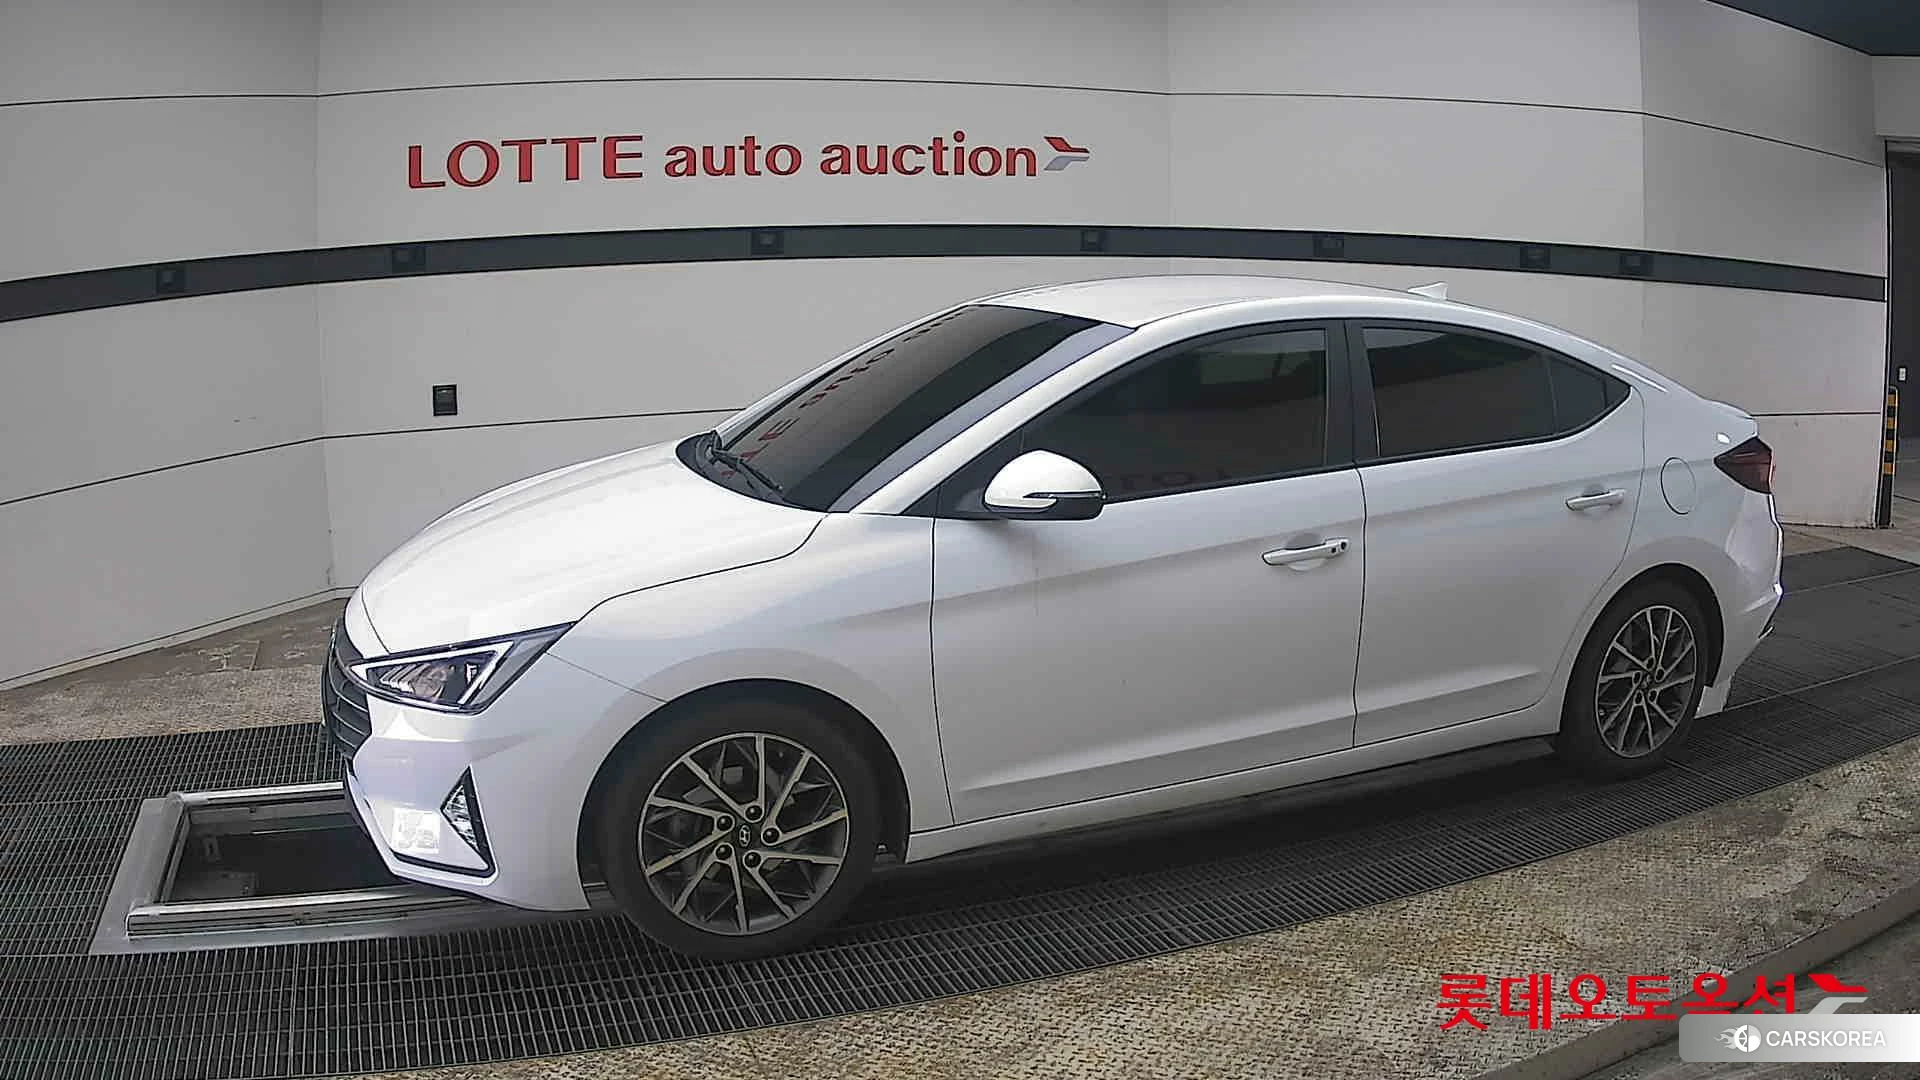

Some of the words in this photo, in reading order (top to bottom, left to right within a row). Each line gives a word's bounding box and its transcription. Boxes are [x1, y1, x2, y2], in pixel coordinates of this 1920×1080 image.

[407, 134, 644, 190] LOTTE
[664, 135, 802, 178] auto
[820, 130, 1038, 177] auction
